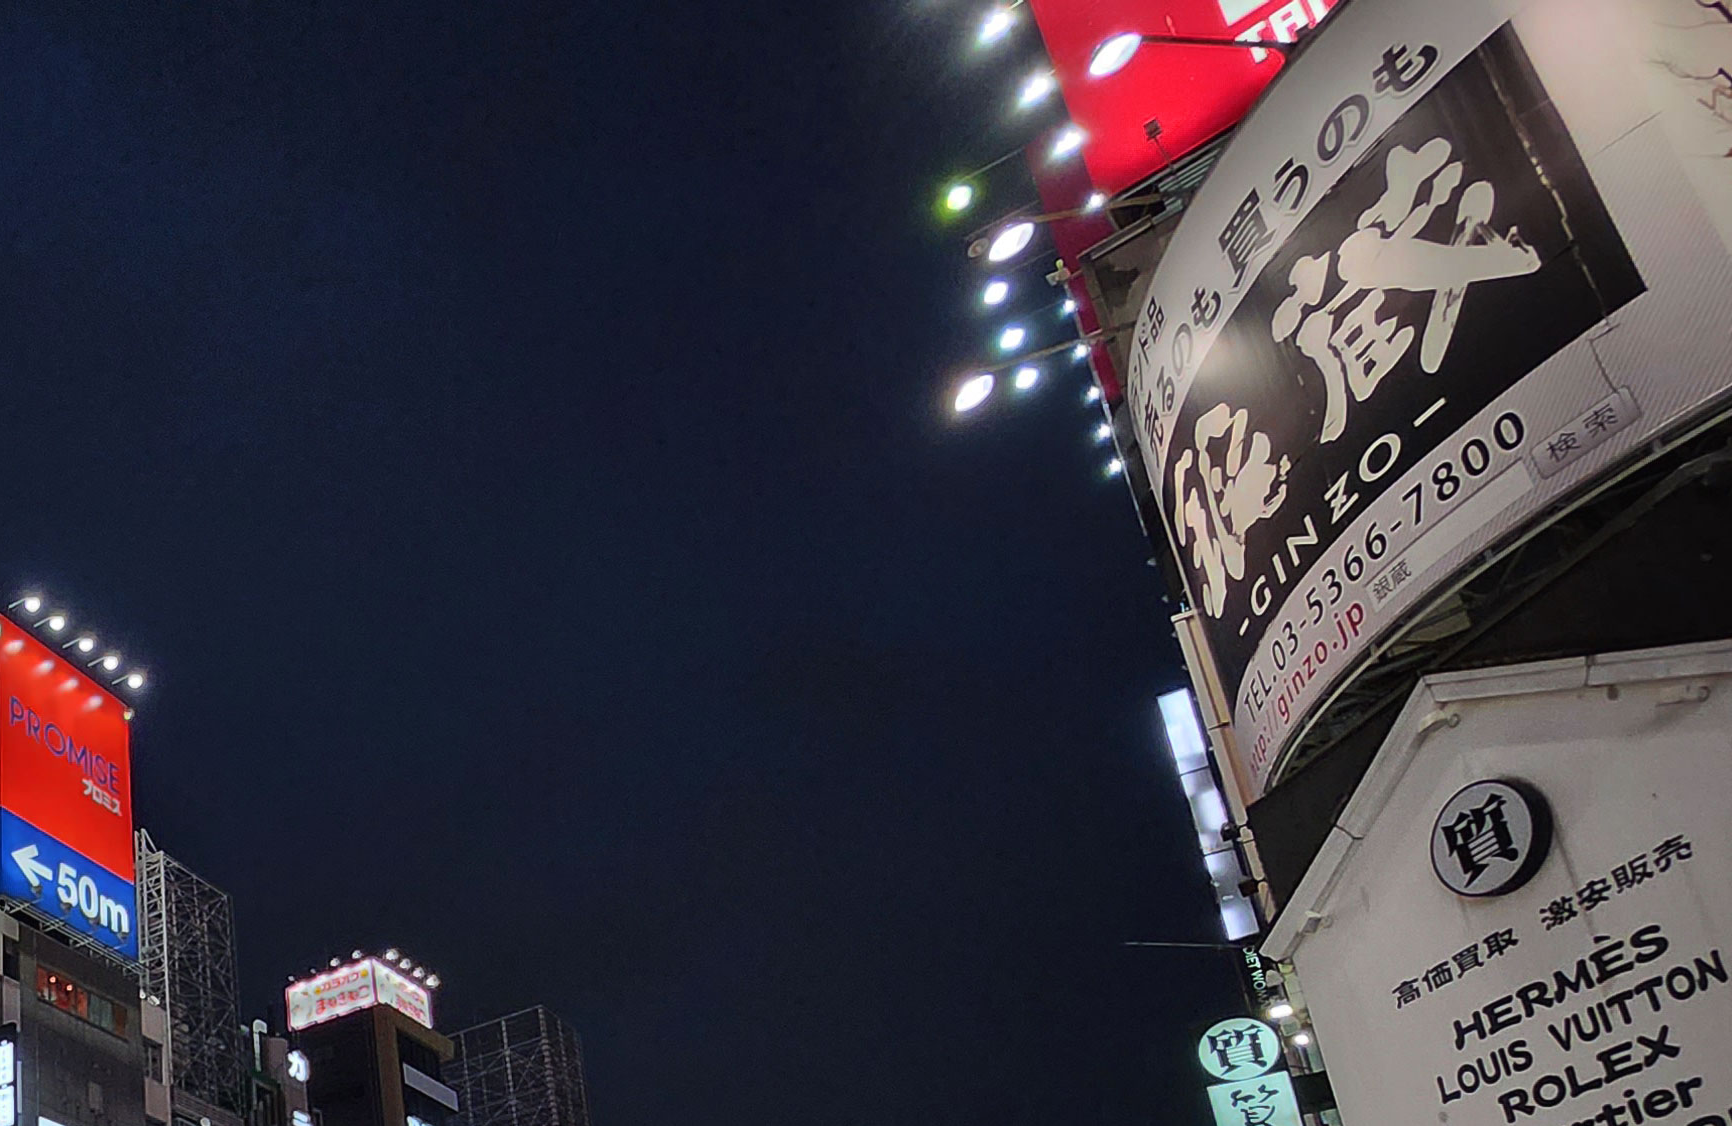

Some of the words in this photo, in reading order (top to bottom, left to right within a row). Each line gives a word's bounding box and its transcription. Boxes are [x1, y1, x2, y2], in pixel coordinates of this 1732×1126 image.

[1545, 402, 1619, 463] 検索
[9, 695, 121, 795] PROMISE
[82, 777, 122, 816] プロミス
[1440, 792, 1520, 891] 質
[57, 862, 130, 934] 50m
[1390, 926, 1520, 1010] 高価買取
[1538, 833, 1693, 933] 激安販売
[1436, 1039, 1535, 1105] LOUIS
[1547, 949, 1730, 1052] VUITTON
[1452, 924, 1670, 1050] HERMÈS
[1496, 1025, 1682, 1124] ROLEX
